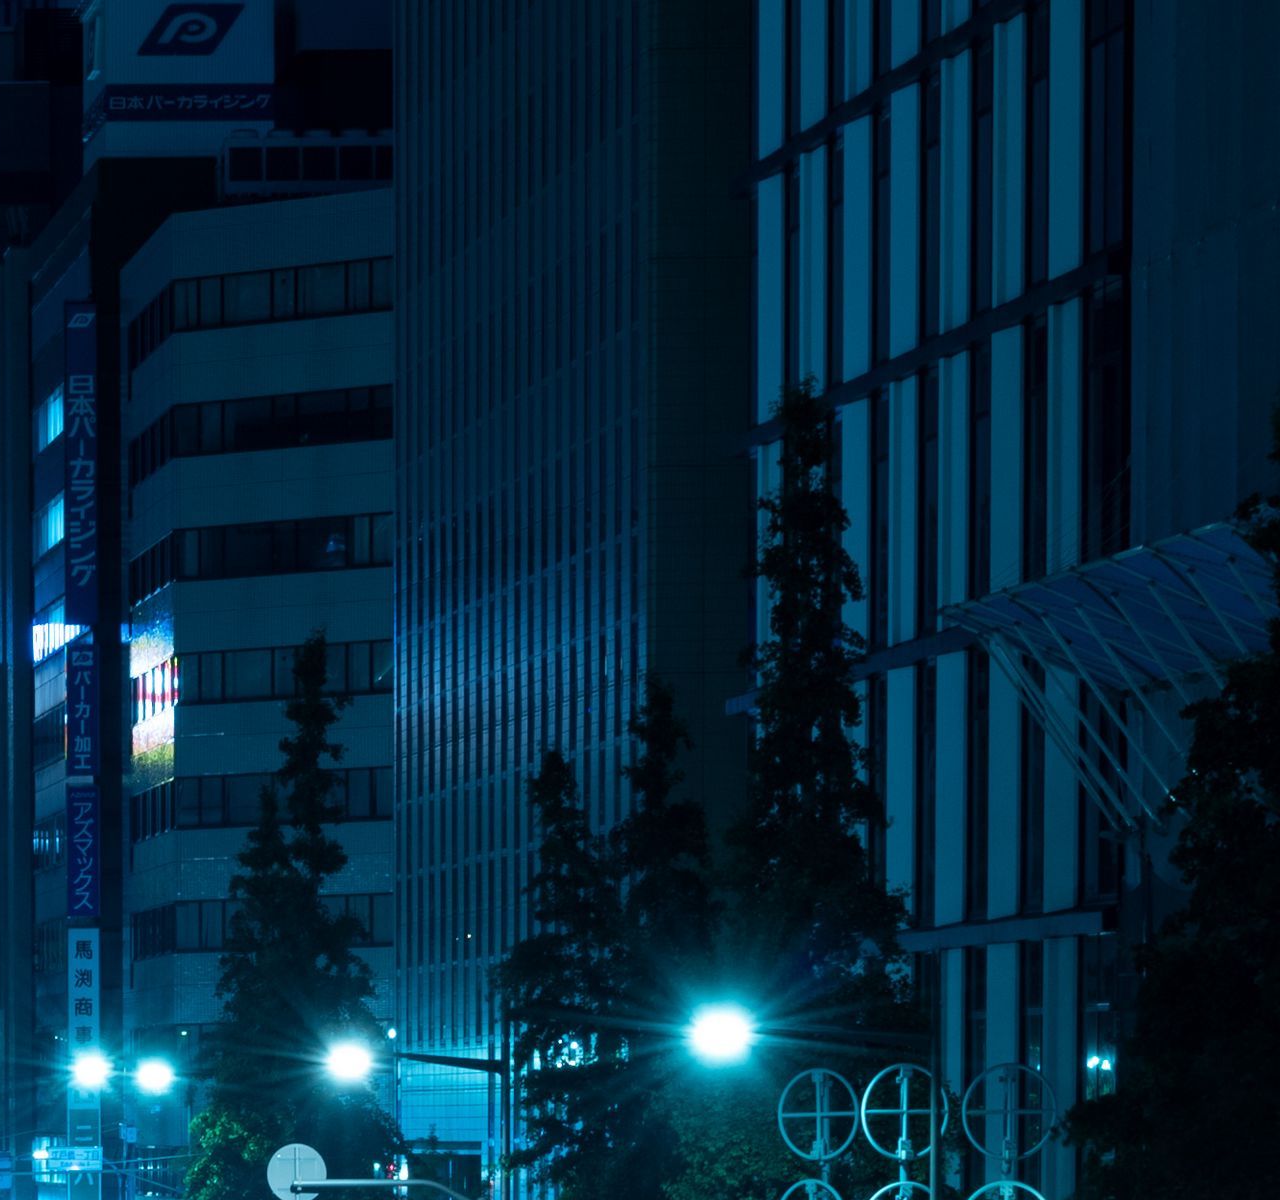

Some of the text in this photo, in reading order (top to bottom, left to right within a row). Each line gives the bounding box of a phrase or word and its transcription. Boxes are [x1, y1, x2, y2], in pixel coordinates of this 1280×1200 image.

[109, 94, 271, 110] 日本パーカライジング
[68, 374, 96, 587] 日本パーカライジング
[73, 670, 92, 770] パーカー加工
[72, 802, 93, 910] アズマックス
